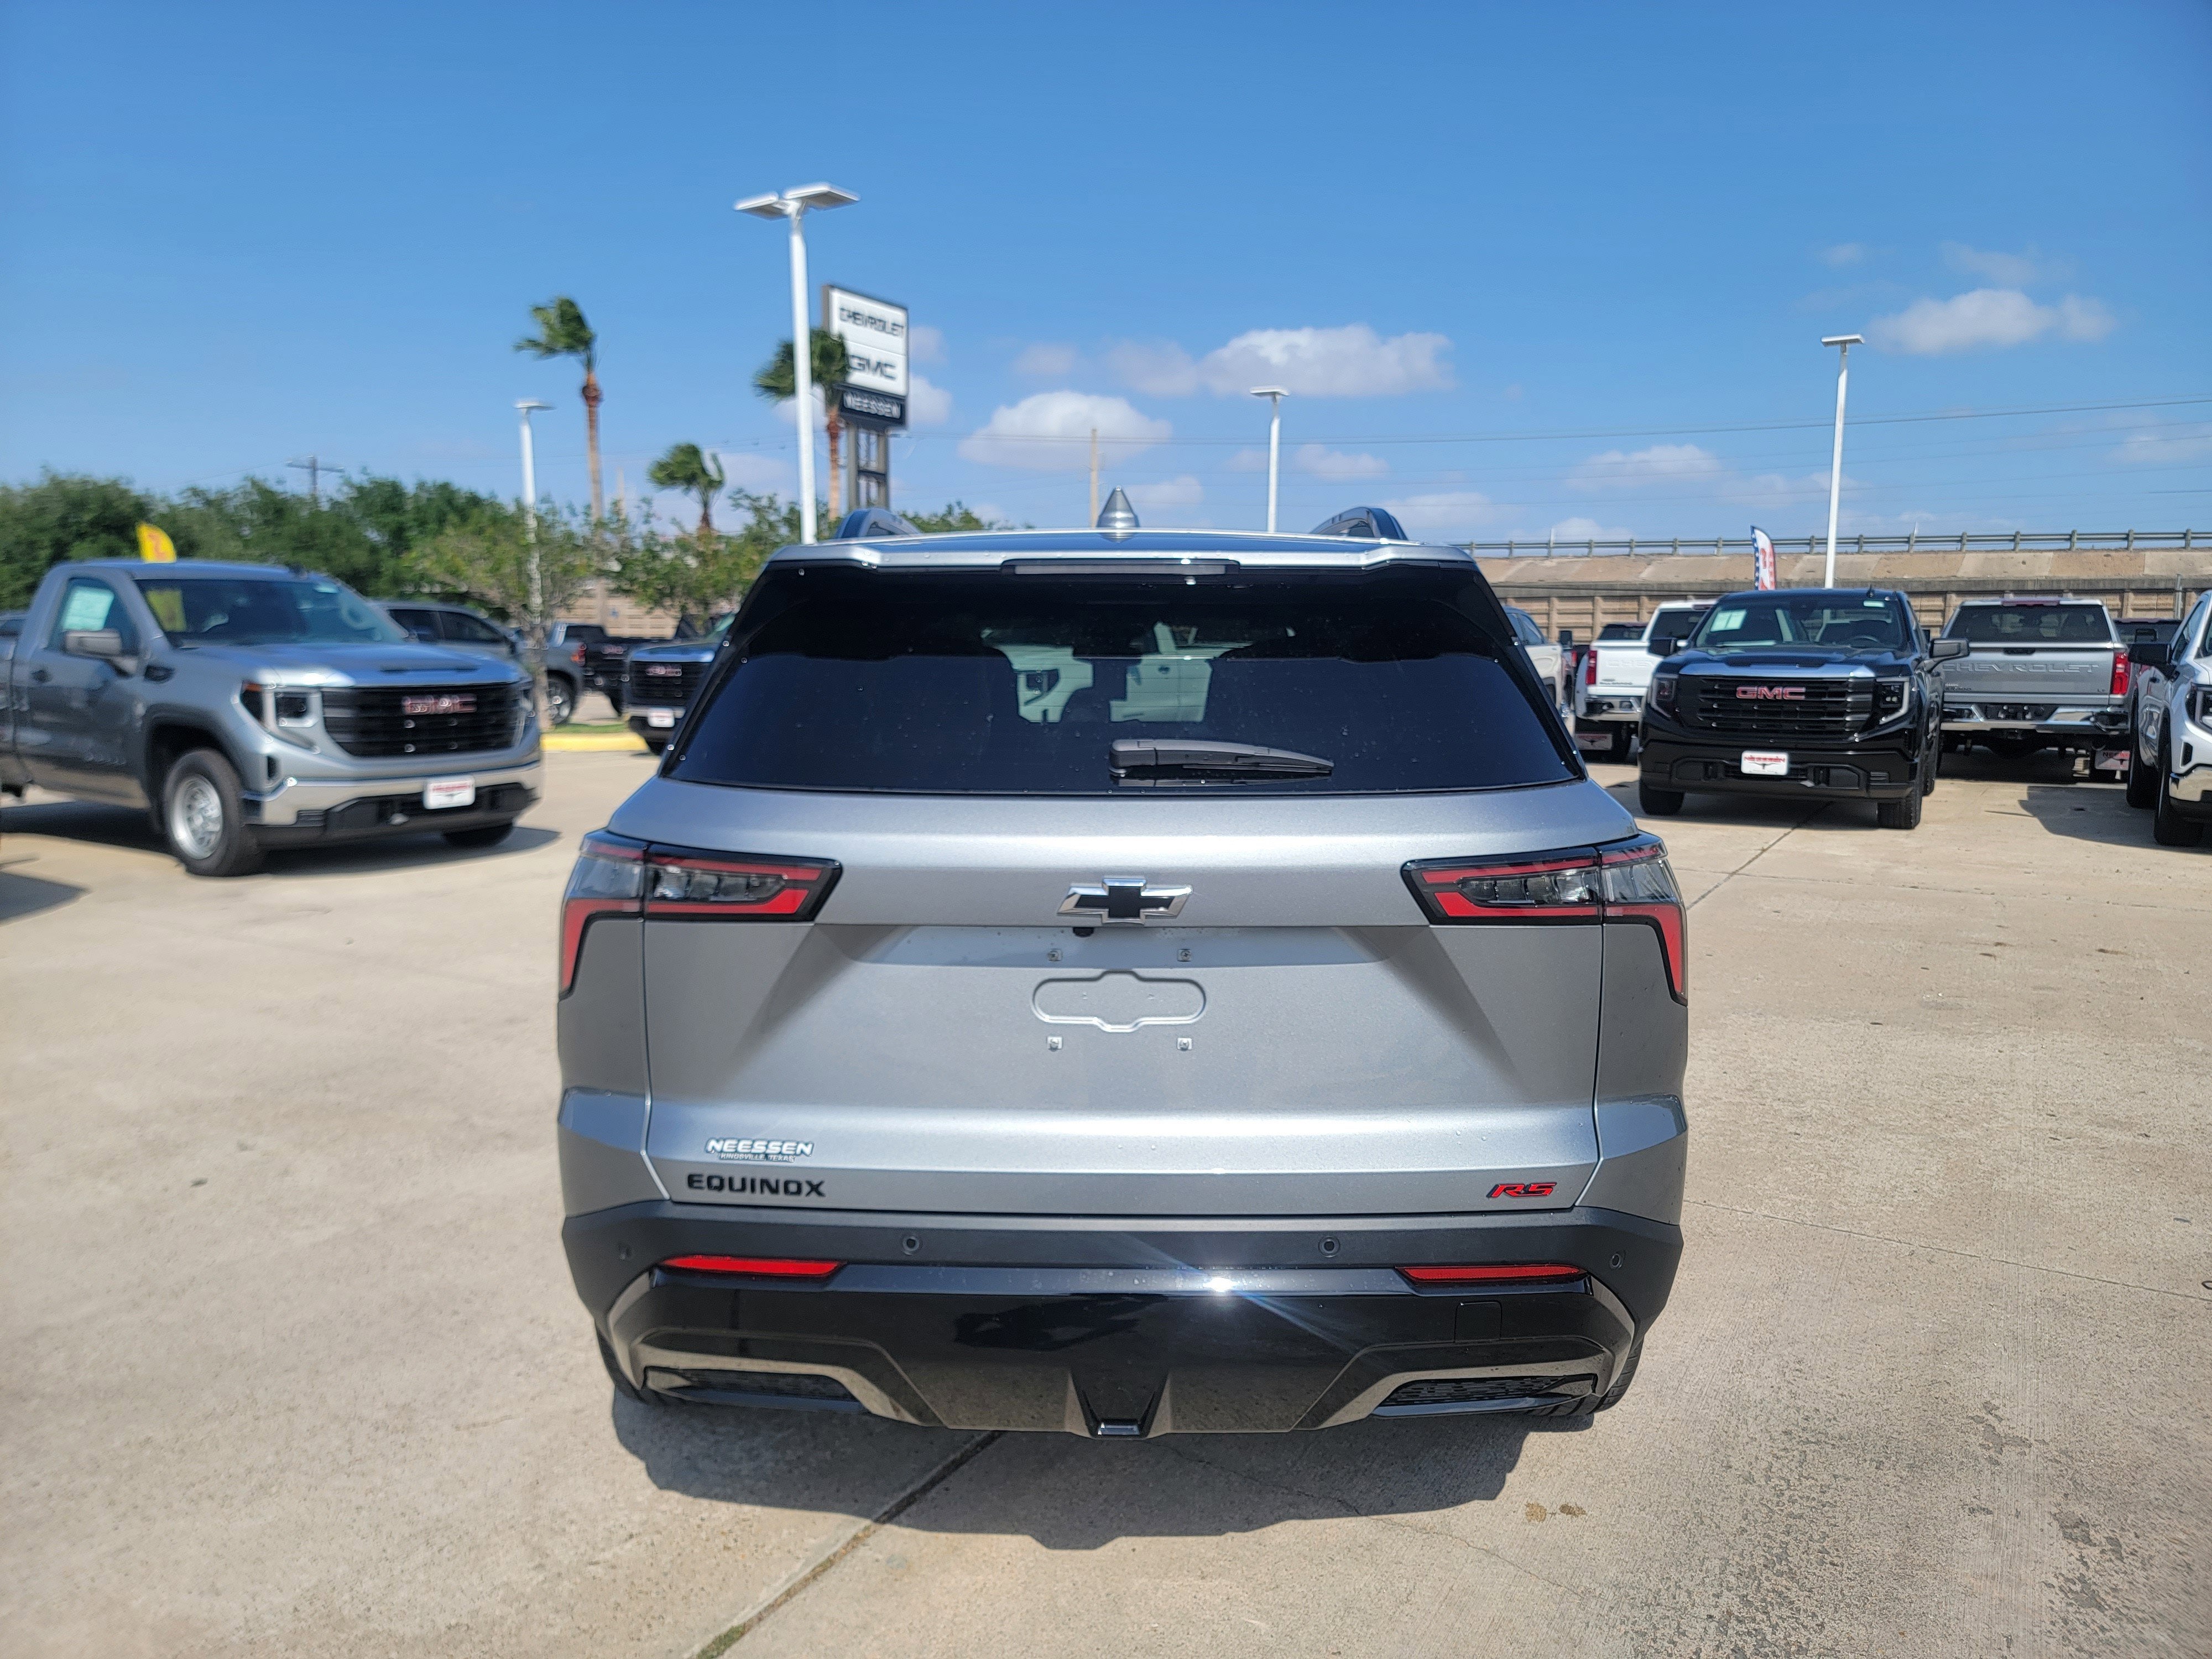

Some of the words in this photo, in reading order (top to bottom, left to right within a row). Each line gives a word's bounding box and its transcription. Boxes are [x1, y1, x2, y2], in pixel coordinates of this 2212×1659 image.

[1942, 664, 2099, 673] CHEVROLET
[1736, 686, 1806, 700] GMC
[706, 1138, 814, 1157] NEESSEN
[687, 1173, 826, 1197] EQUINOX
[1486, 1182, 1557, 1198] RS
